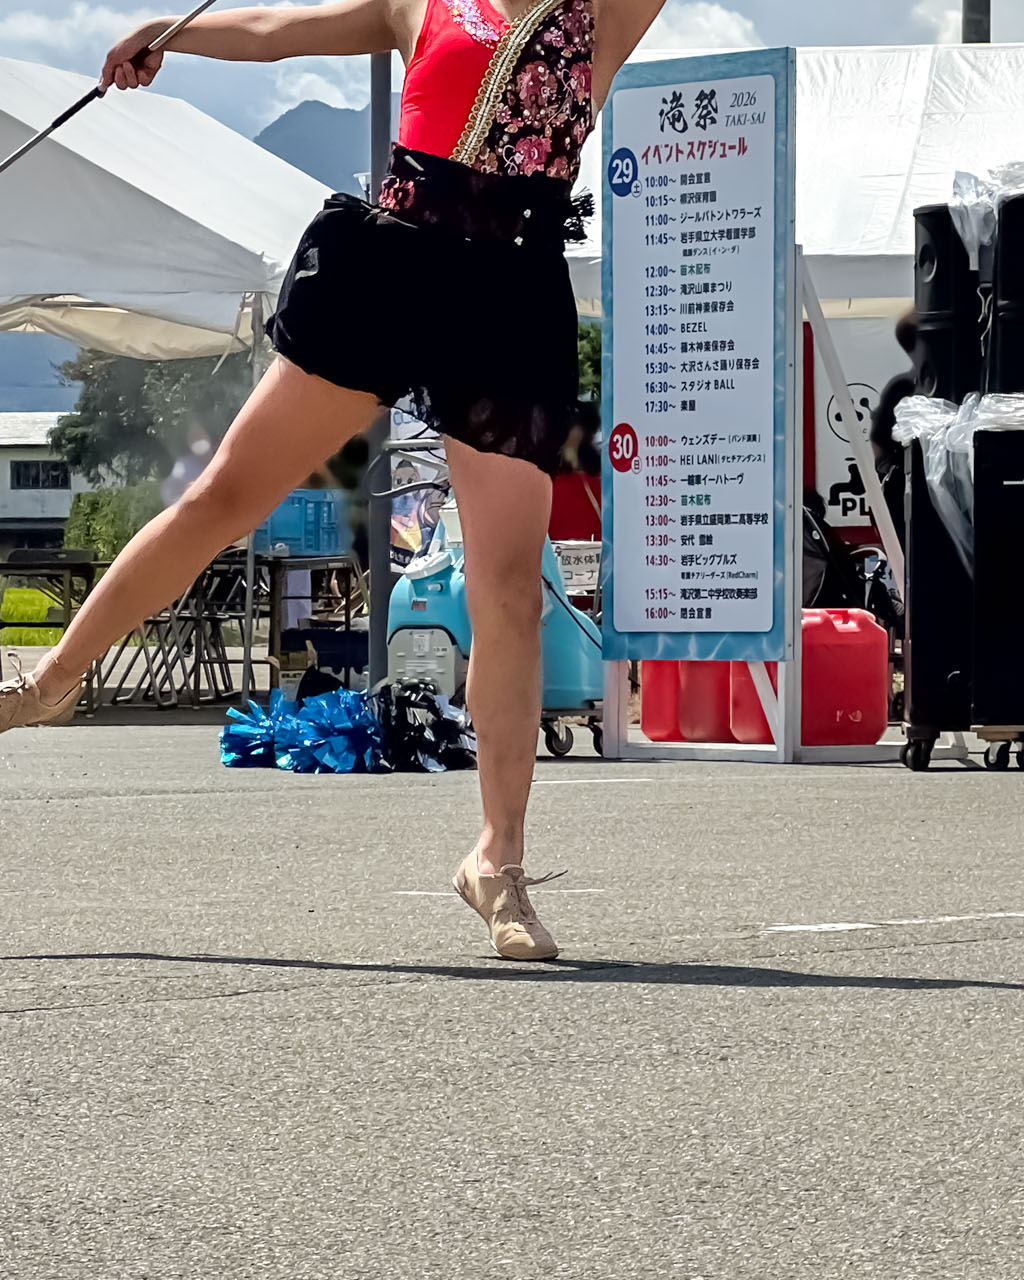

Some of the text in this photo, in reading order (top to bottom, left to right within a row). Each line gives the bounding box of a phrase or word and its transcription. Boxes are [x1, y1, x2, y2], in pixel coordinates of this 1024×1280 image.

[730, 91, 757, 108] 2026
[725, 111, 766, 127] TAKI-SAI
[641, 136, 748, 166] イベントスケジュール
[612, 157, 633, 184] 29
[680, 172, 711, 186] 開会宣言
[680, 206, 762, 224] ジールバトントワラーズ
[680, 226, 756, 244] 岩手県立大学看護学部
[680, 263, 711, 276] 苗木配布
[680, 322, 708, 333] BEZEL
[680, 357, 761, 373] 大沢さんさ踊り保存会
[680, 380, 712, 392] スタジオ
[714, 378, 736, 391] BALL
[612, 433, 633, 460] 30
[680, 433, 727, 447] ウェンズデー
[680, 455, 694, 466] HEI
[680, 494, 712, 507] 苗木配布
[680, 512, 769, 527] 岩手県立盛岡第二高等学校
[680, 553, 738, 567] 岩手ビッグブルズ
[680, 606, 712, 620] 閉会宣言
